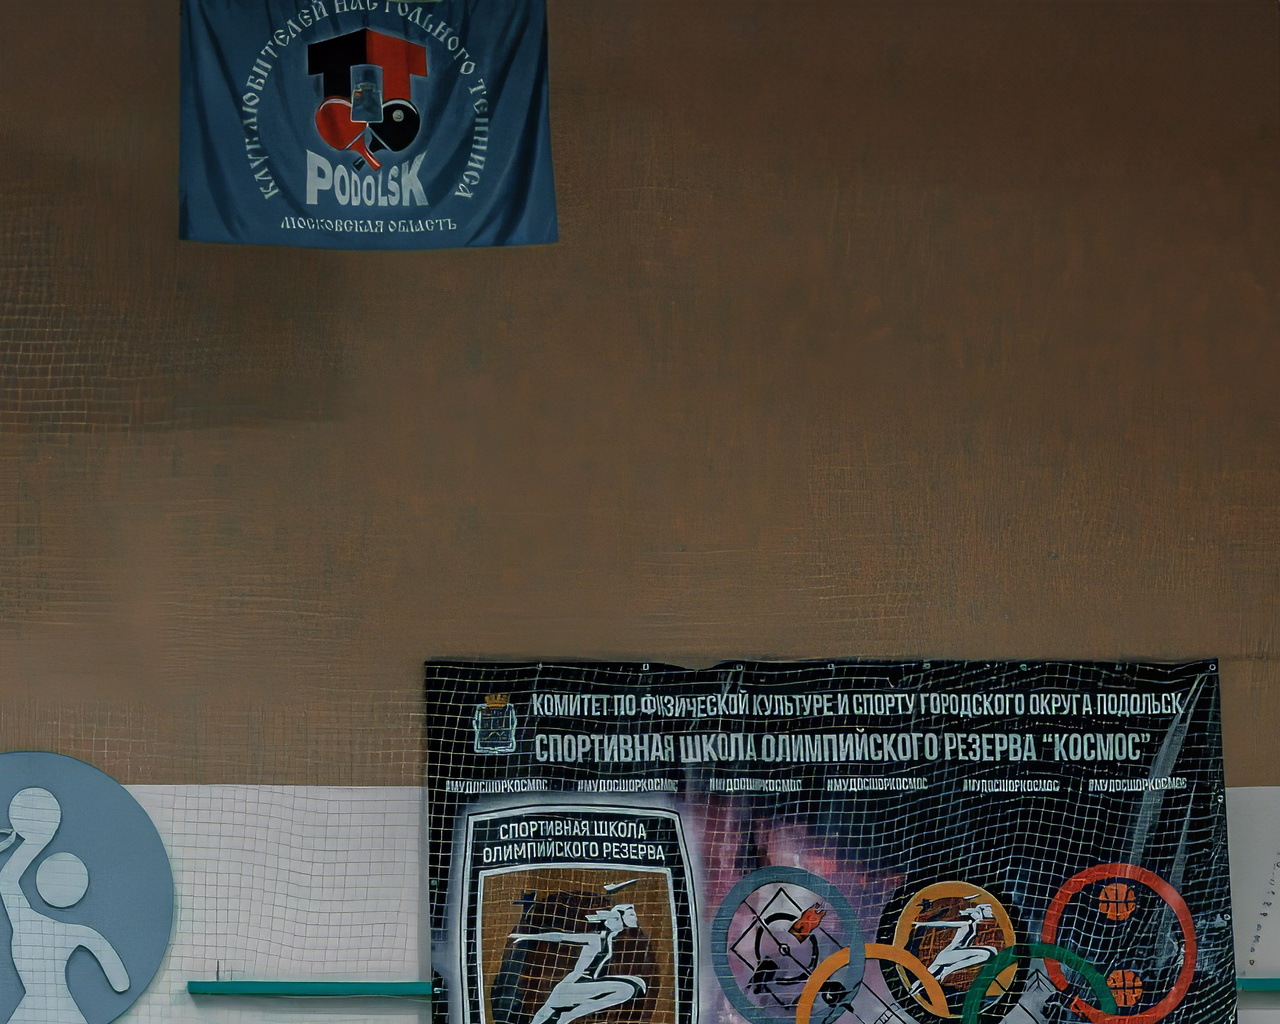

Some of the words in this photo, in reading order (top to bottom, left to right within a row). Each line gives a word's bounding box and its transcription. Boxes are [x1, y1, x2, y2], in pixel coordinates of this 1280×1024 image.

[532, 693, 609, 717] КОМИТЕТ
[613, 693, 636, 716] ПО
[641, 690, 749, 718] ФИЗИЧЕСКОЙ
[752, 693, 833, 716] КУЛЬТУРЕ
[837, 693, 849, 715] И
[853, 693, 914, 716] СПОРТУ
[920, 693, 1025, 718] ГОРОДСКОГО
[1029, 693, 1093, 716] ОКРУГА
[1097, 693, 1183, 717] ПОДОЛЬСК
[535, 733, 675, 763] СПОРТИВНАЯ
[679, 733, 756, 763] ШКОЛА
[762, 728, 938, 762] ОЛИМПИЙСКОГО
[944, 732, 1036, 762] РЕЗЕРВА
[499, 820, 591, 840] СПОРТИВНАЯ
[594, 821, 647, 839] ШКОЛА
[482, 840, 599, 864] ОЛИМПИЙСКОГО
[603, 842, 665, 861] РЕЗЕРВА
